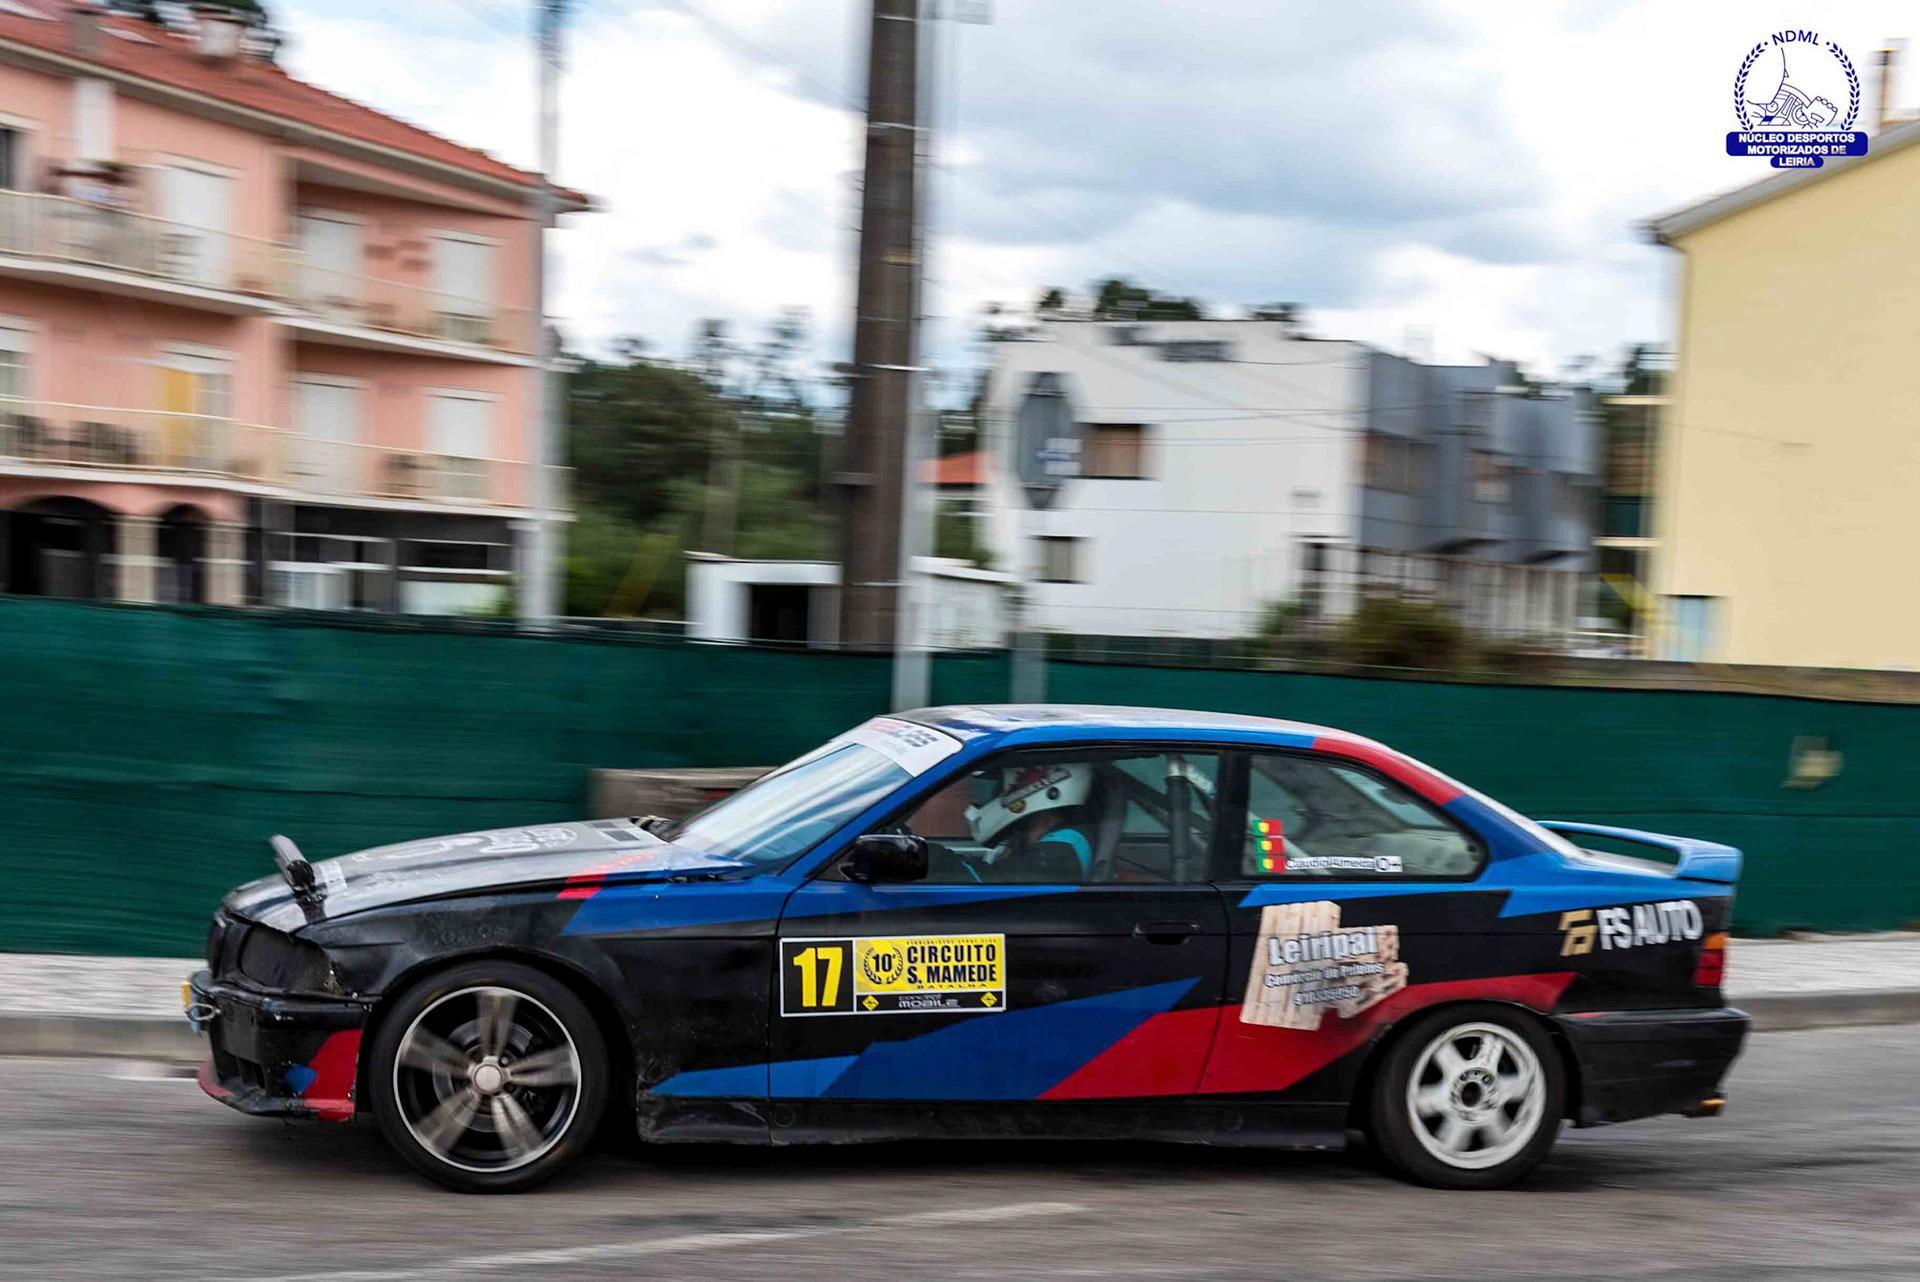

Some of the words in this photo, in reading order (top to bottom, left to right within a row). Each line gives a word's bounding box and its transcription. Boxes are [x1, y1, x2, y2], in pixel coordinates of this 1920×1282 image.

[1596, 907, 1632, 950] FS
[1633, 900, 1704, 946] AUTO
[907, 944, 997, 964] CIRCUITO
[1267, 926, 1378, 966] Leiripal
[793, 947, 843, 1008] 17
[907, 965, 923, 984] S.
[926, 964, 997, 983] MAMEDE
